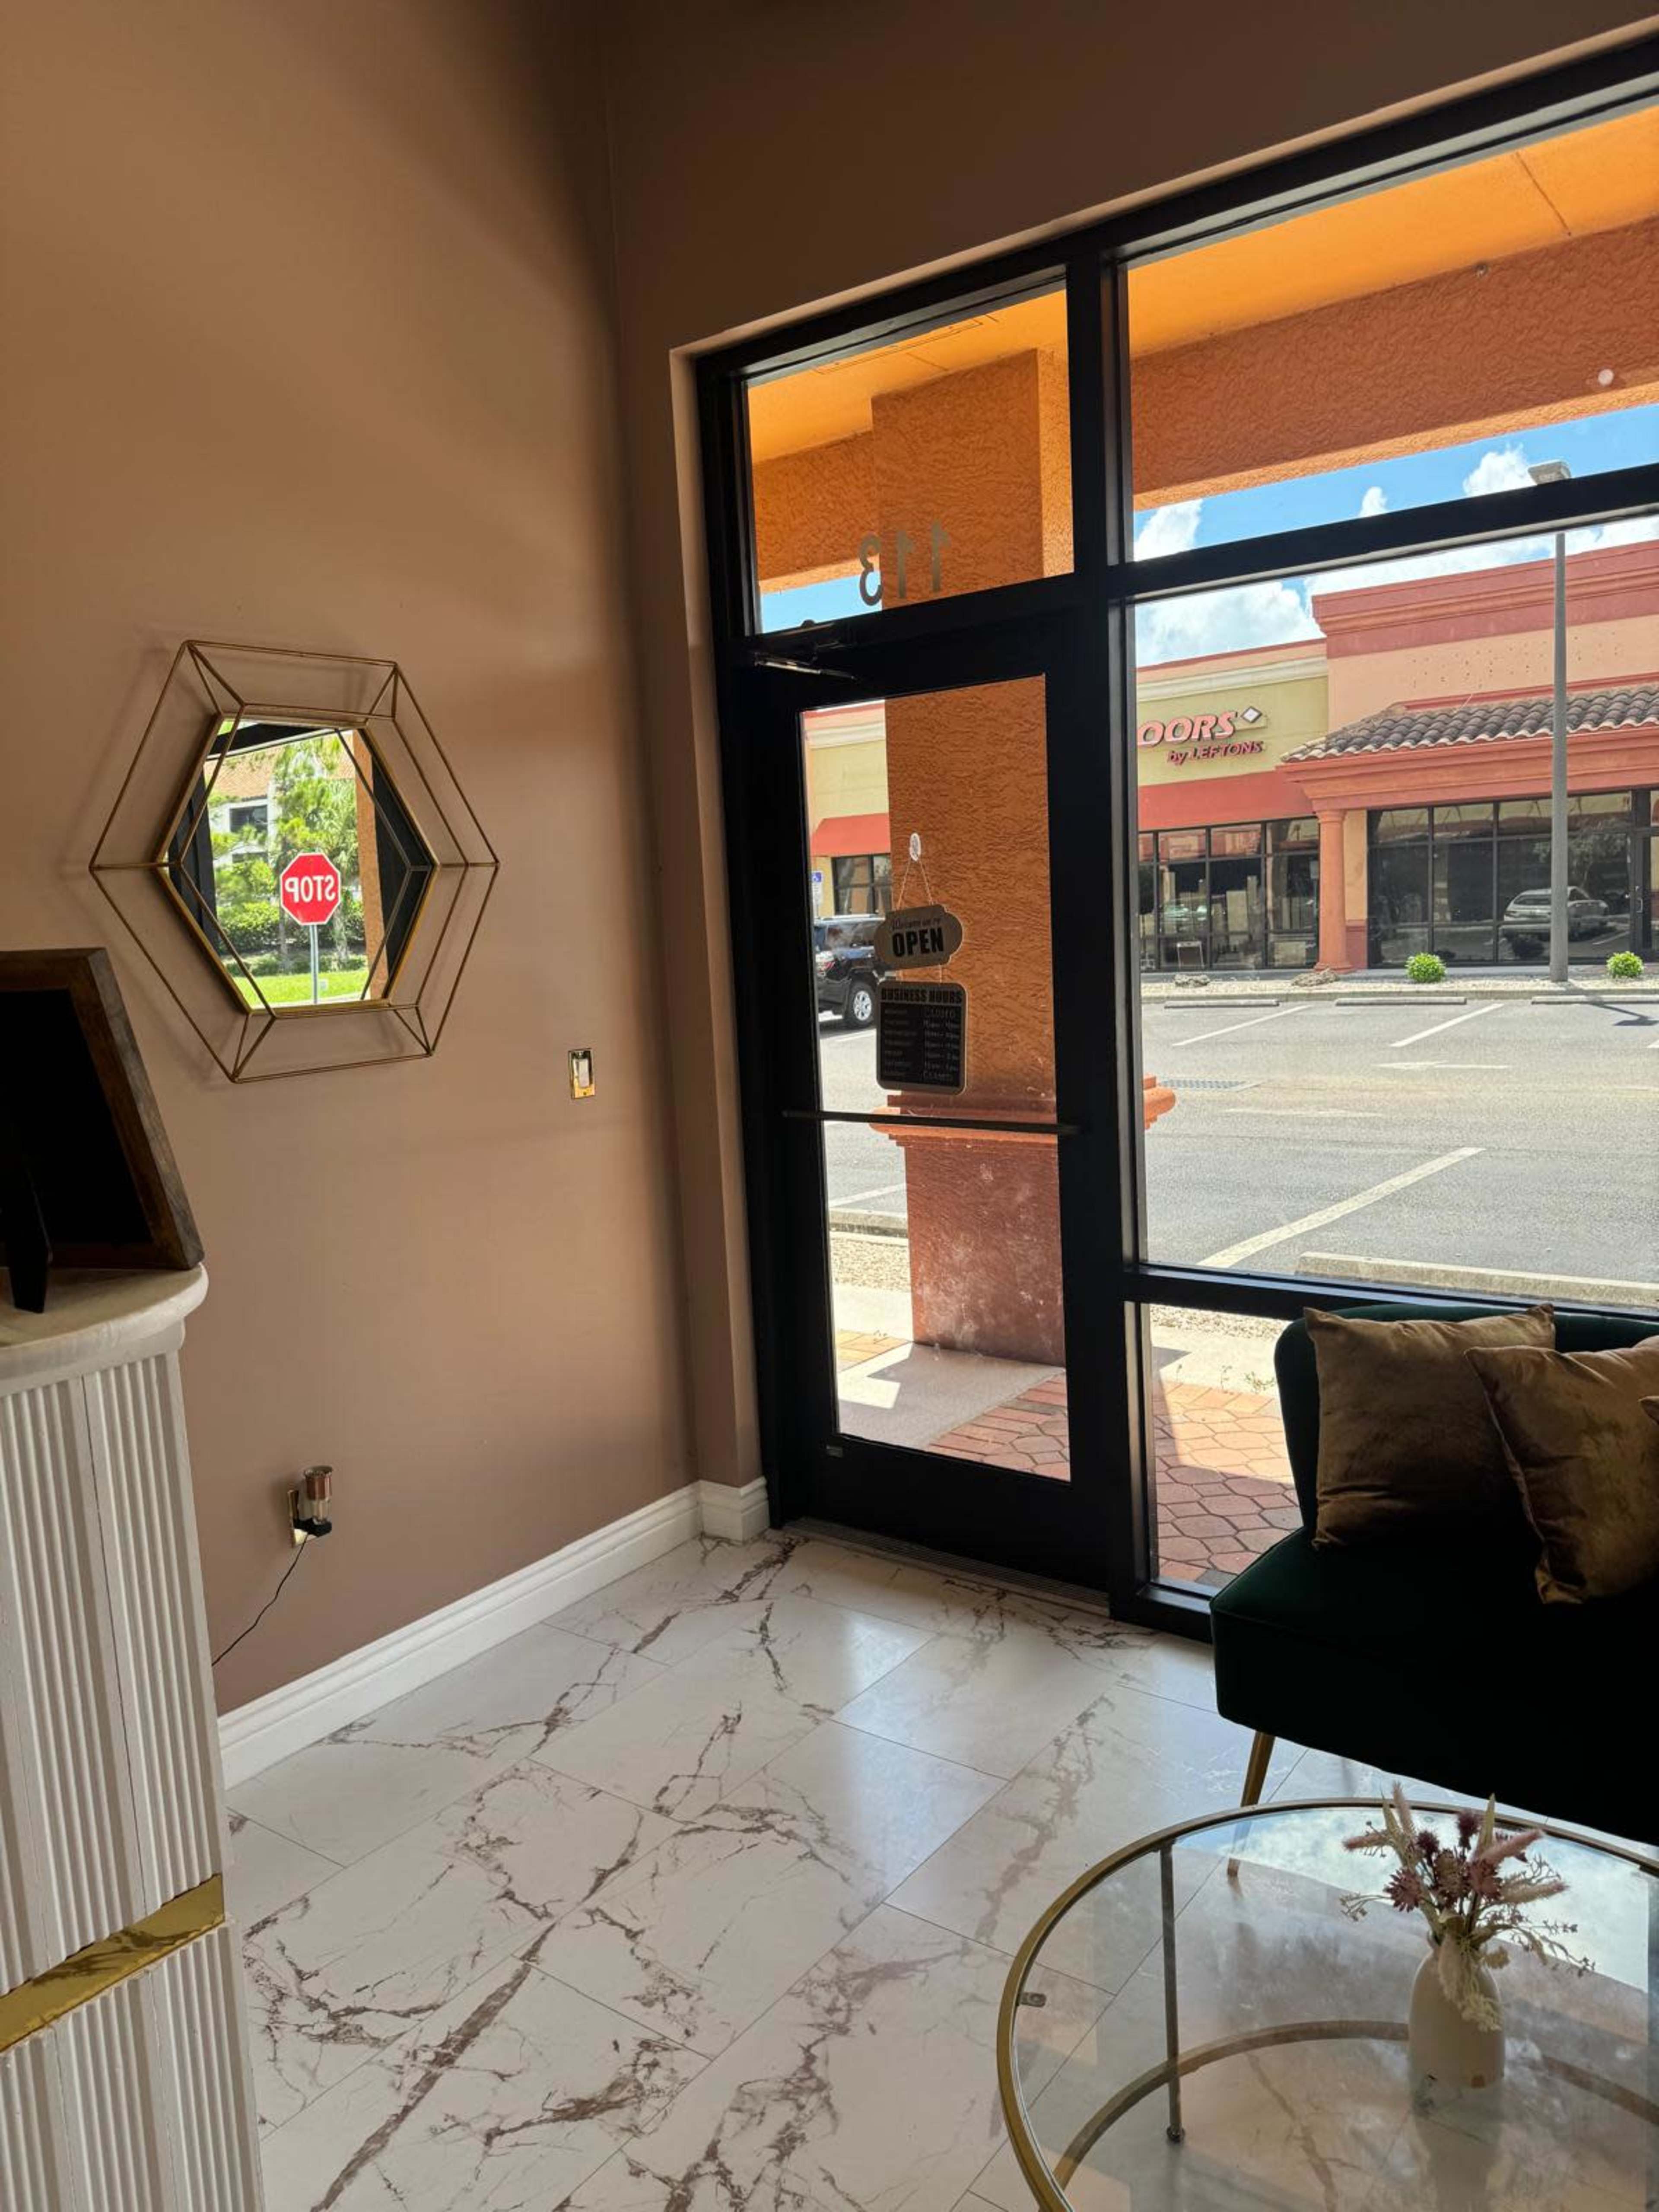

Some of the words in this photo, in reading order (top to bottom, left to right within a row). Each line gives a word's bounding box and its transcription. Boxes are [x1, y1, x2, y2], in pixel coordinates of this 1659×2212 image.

[1167, 750, 1187, 764] by
[1191, 741, 1264, 759] LEFTONS
[892, 927, 944, 957] OPEN
[881, 988, 927, 1001] BUSINESS
[929, 990, 962, 1004] HOURS
